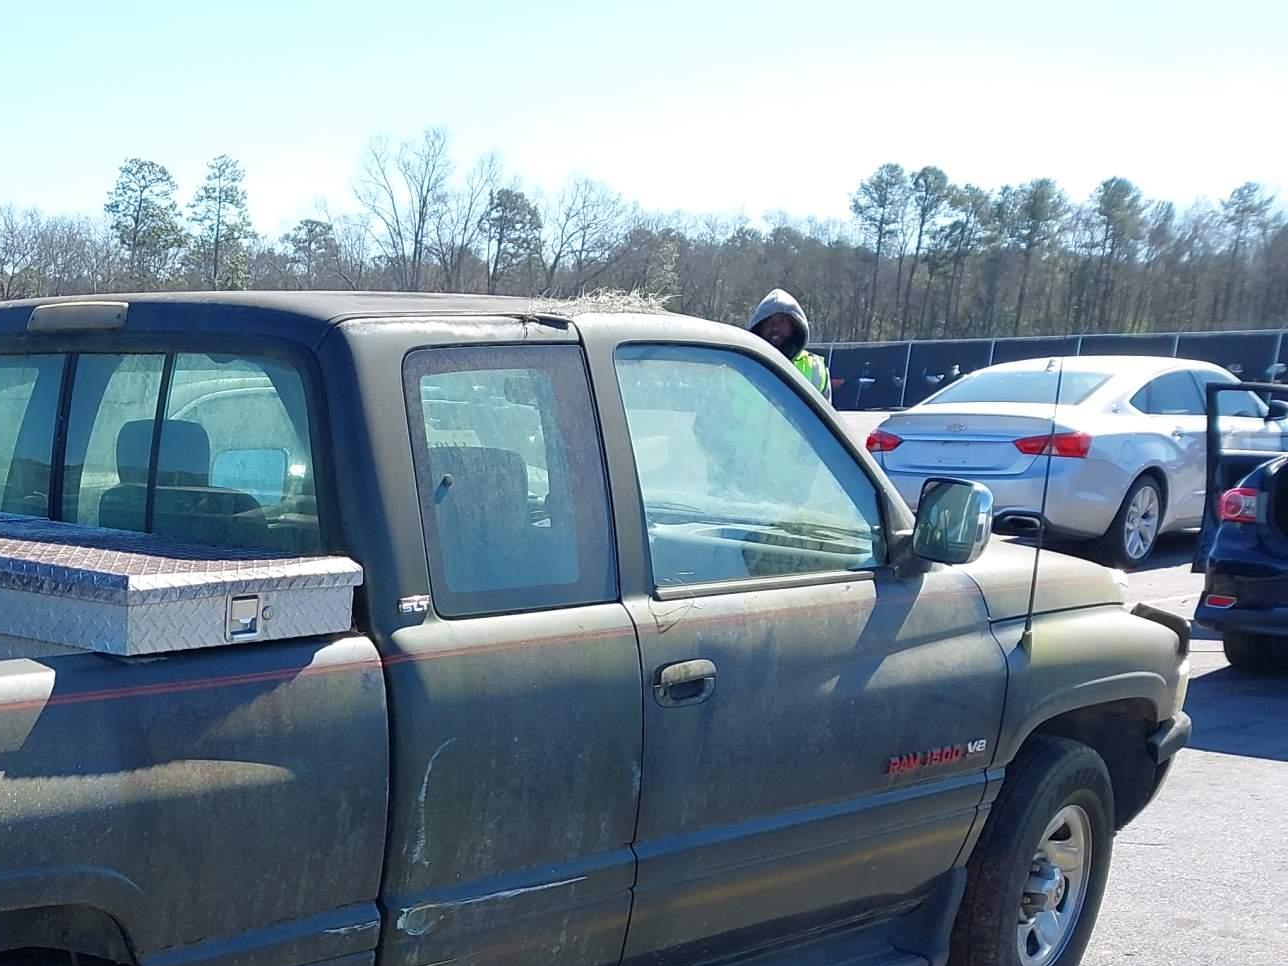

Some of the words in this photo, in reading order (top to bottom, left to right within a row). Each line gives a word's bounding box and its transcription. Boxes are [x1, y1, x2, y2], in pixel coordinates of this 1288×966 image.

[402, 600, 429, 613] SLT
[887, 753, 921, 777] RAM
[924, 745, 963, 768] 1500
[967, 739, 987, 753] V8
